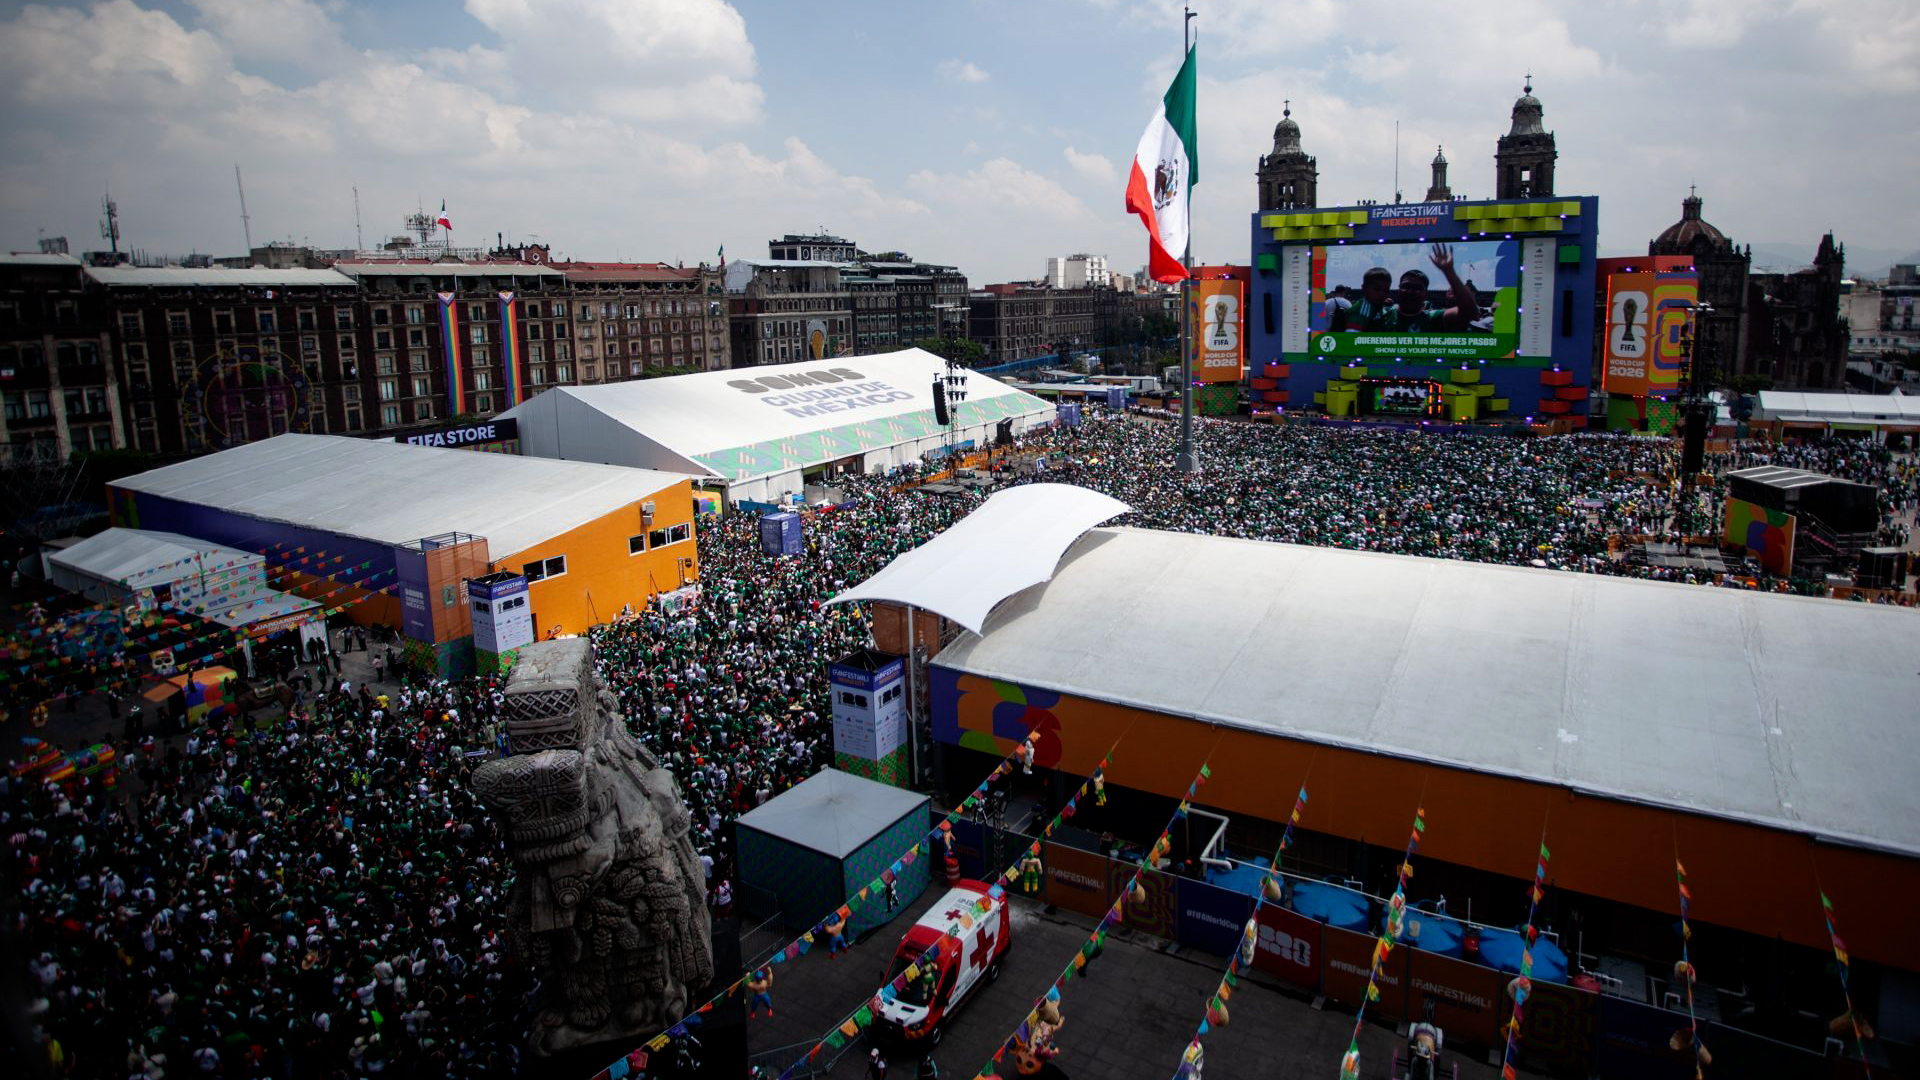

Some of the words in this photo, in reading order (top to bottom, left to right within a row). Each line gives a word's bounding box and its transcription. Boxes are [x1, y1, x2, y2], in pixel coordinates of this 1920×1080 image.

[1381, 217, 1416, 226] MEXICO
[1416, 216, 1438, 225] CITY
[1354, 336, 1397, 346] ¡QUEREMOS
[1398, 337, 1413, 345] VER
[1414, 337, 1429, 345] TUS
[1430, 337, 1467, 346] MEJORES
[1468, 337, 1498, 346] PASOS!
[1620, 344, 1637, 352] FIFA
[1204, 359, 1238, 368] 2026
[1609, 358, 1632, 367] WORLD
[1609, 366, 1645, 378] 2026
[726, 367, 866, 394] SOMOS
[760, 382, 856, 407] CIUDAD
[857, 381, 894, 392] DE
[407, 432, 446, 447] FIFA
[446, 425, 496, 445] STORE
